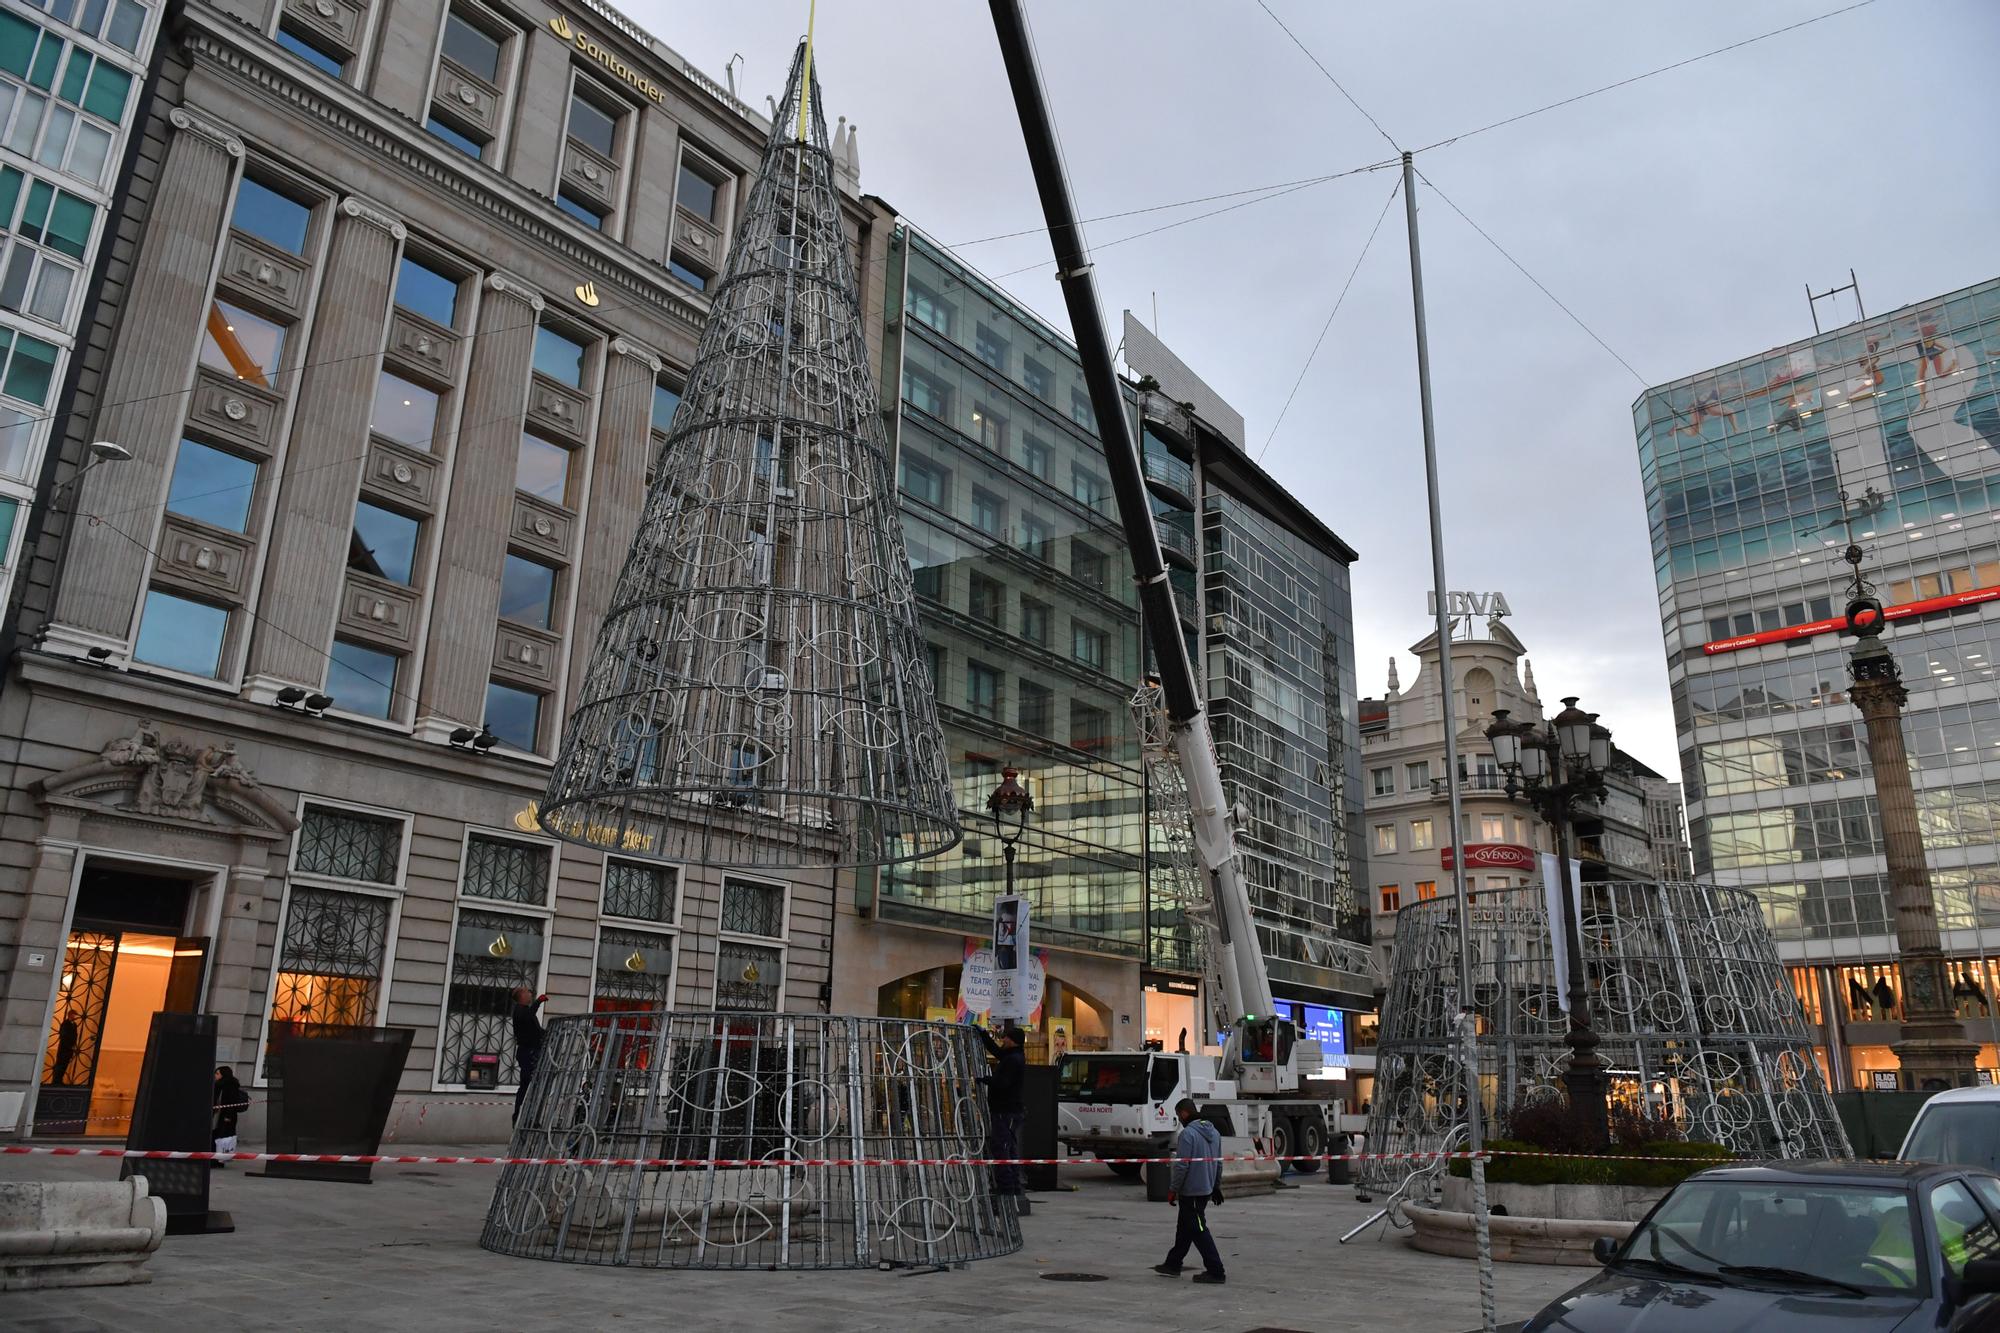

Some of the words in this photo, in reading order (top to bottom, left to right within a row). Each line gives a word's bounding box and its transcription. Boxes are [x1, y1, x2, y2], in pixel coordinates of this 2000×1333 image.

[575, 32, 666, 103] Santander
[1480, 849, 1520, 861] SVENSON
[1875, 1073, 1896, 1081] BLACK
[1875, 1081, 1897, 1089] FRIDAY
